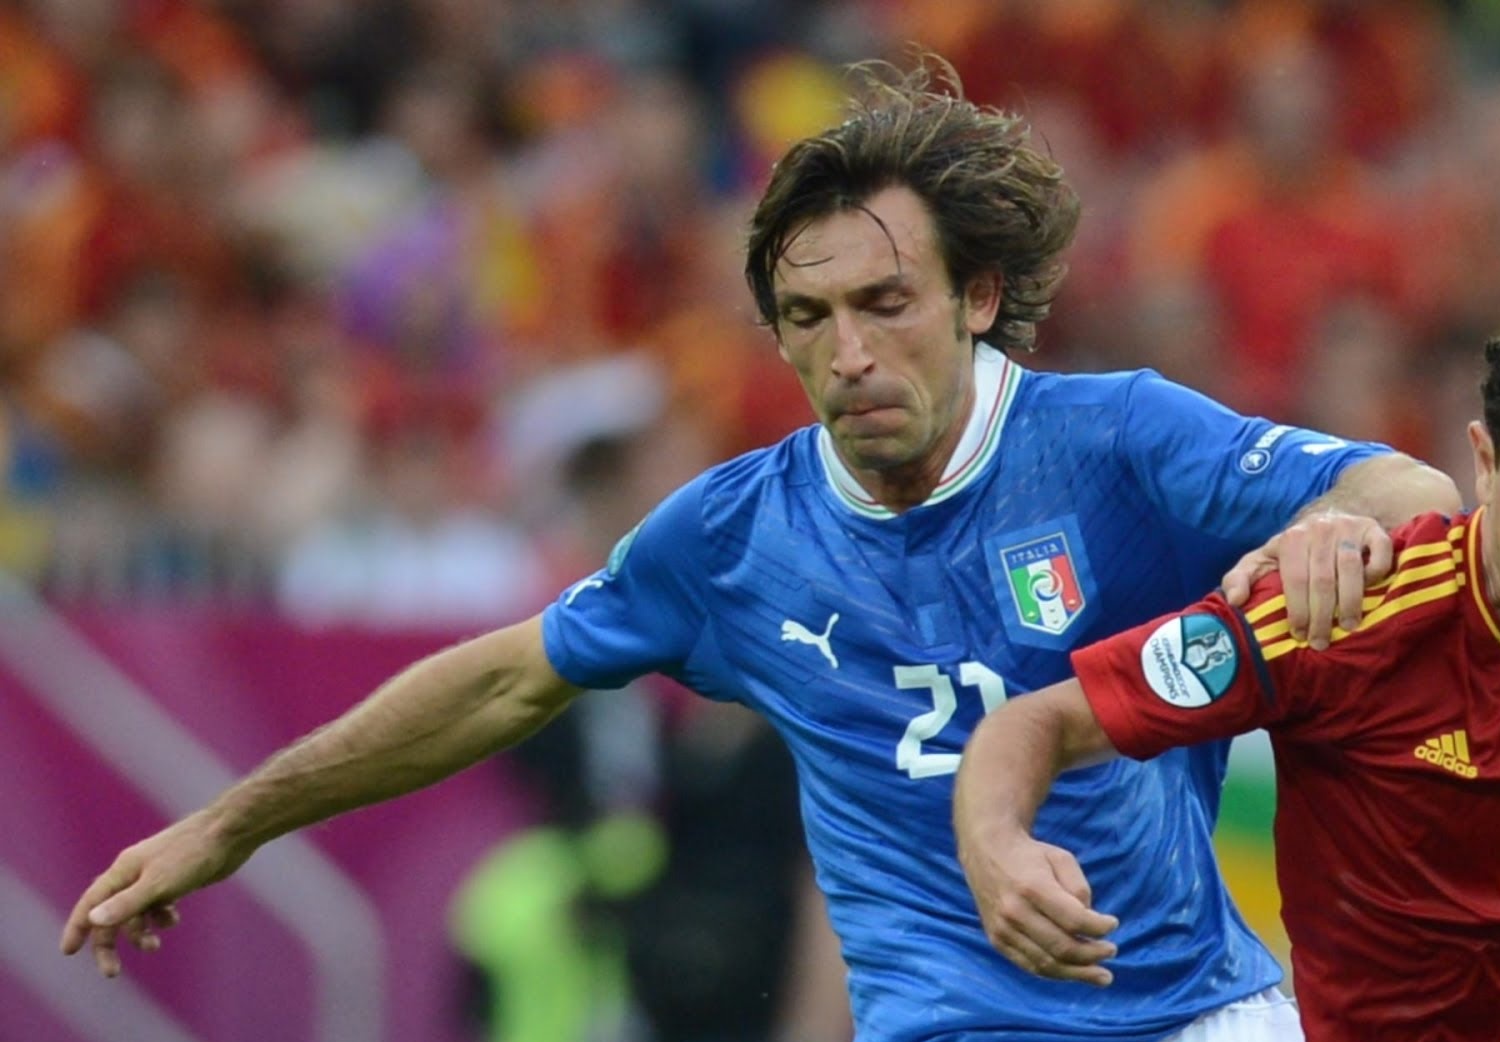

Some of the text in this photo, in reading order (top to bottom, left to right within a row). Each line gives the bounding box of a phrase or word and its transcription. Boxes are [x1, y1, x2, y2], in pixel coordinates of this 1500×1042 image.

[1009, 542, 1060, 563] ITALIA
[893, 661, 1008, 780] 21
[1413, 745, 1478, 779] adidas
